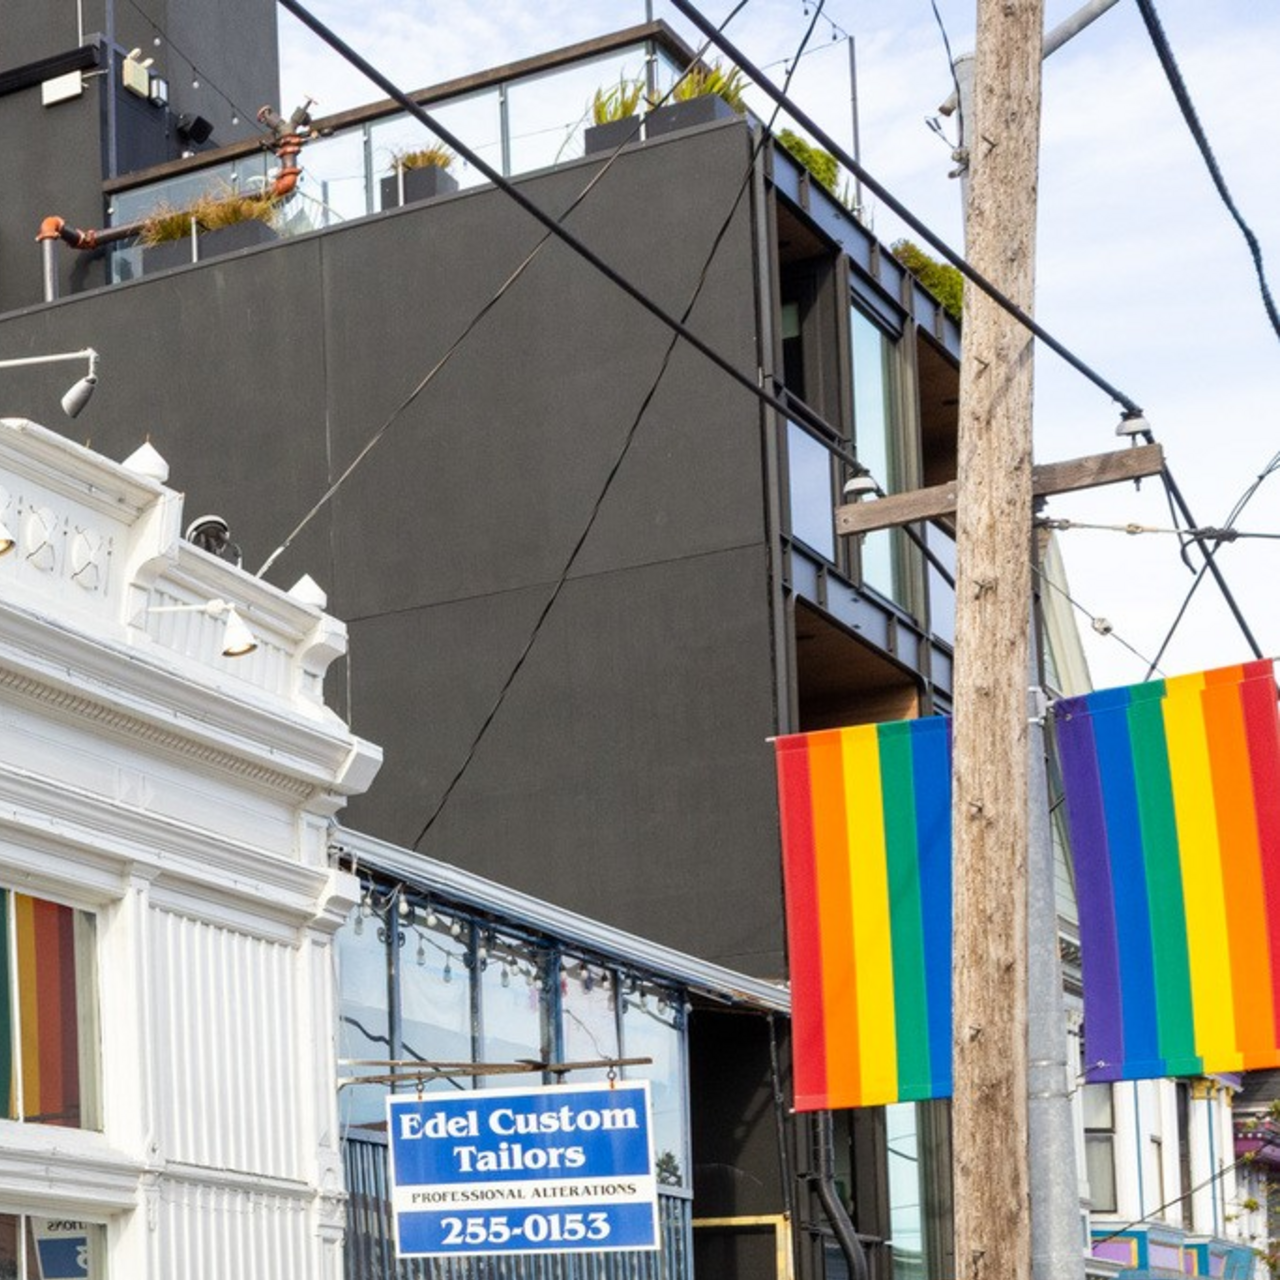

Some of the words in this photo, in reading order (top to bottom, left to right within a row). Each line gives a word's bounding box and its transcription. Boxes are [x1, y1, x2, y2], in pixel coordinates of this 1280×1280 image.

[400, 1110, 480, 1140] Edel
[489, 1105, 639, 1134] Custom
[453, 1143, 586, 1172] Tailors
[411, 1187, 526, 1204] PROFESSIONAL
[531, 1182, 637, 1198] ALTERATIONS
[441, 1213, 611, 1245] 255-0153
